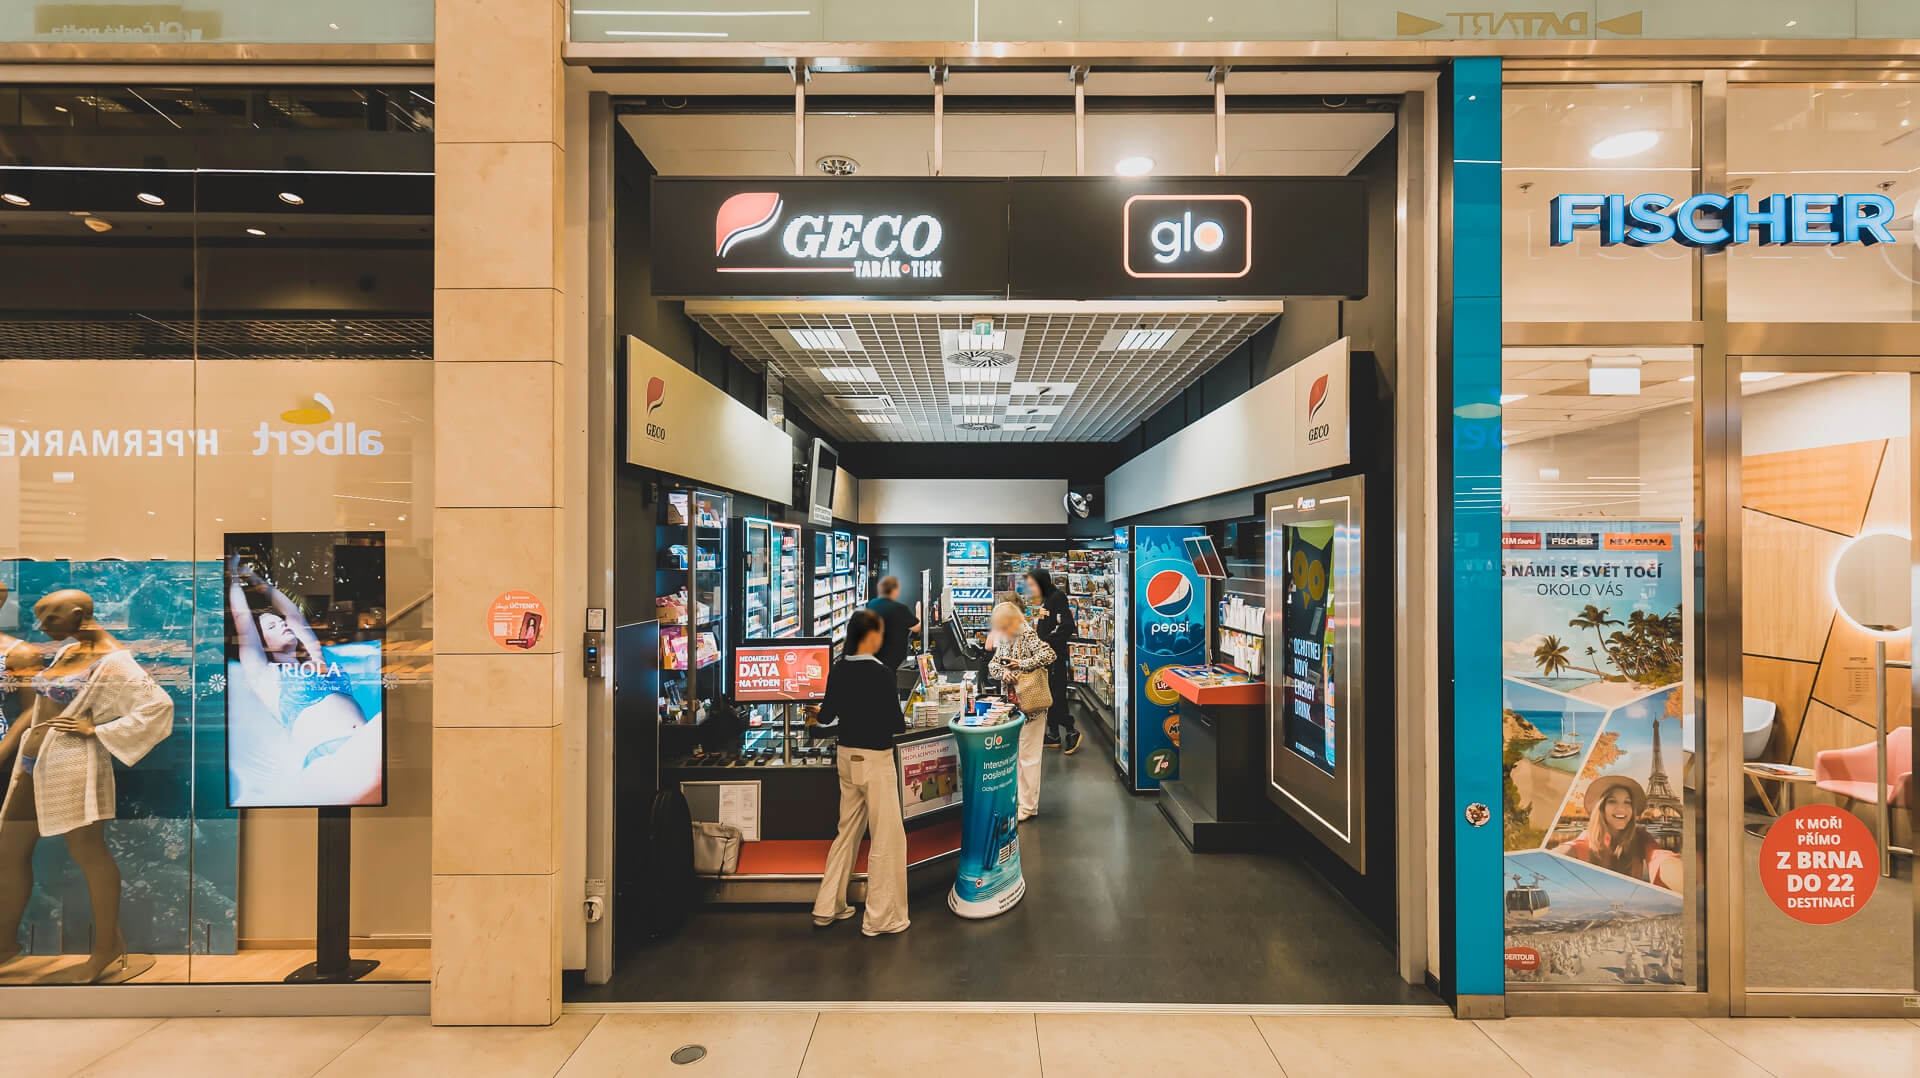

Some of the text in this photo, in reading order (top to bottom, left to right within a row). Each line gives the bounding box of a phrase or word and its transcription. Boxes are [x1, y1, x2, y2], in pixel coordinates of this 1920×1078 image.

[1552, 193, 1896, 246] FISCHER
[782, 214, 943, 259] GECO
[1151, 211, 1224, 263] glo
[646, 423, 666, 441] GECO
[1308, 423, 1330, 442] GECO
[1551, 537, 1594, 546] FISCHER
[1609, 538, 1667, 546] NEV-DAMA
[1511, 562, 1555, 578] NÁMI
[1560, 565, 1578, 578] SE
[1582, 563, 1619, 578] SVĚT
[1623, 563, 1663, 579] TOČÍ
[1537, 581, 1624, 597] OKOLO VÁS
[1151, 621, 1190, 636] pepsi
[739, 653, 780, 662] NEOMEZENÁ
[267, 662, 342, 678] TRIOLA
[738, 663, 781, 677] DATA
[752, 677, 780, 687] TÝDEN
[1293, 678, 1315, 702] ENERGY
[984, 733, 1003, 750] glo
[1795, 815, 1842, 829] K MOŘI
[1797, 831, 1840, 845] PŘÍMO
[1776, 850, 1863, 869] Z BRNA
[1787, 873, 1854, 892] DO 22
[1787, 894, 1855, 908] DESTINACÍ
[1504, 953, 1535, 961] DERTOUR
